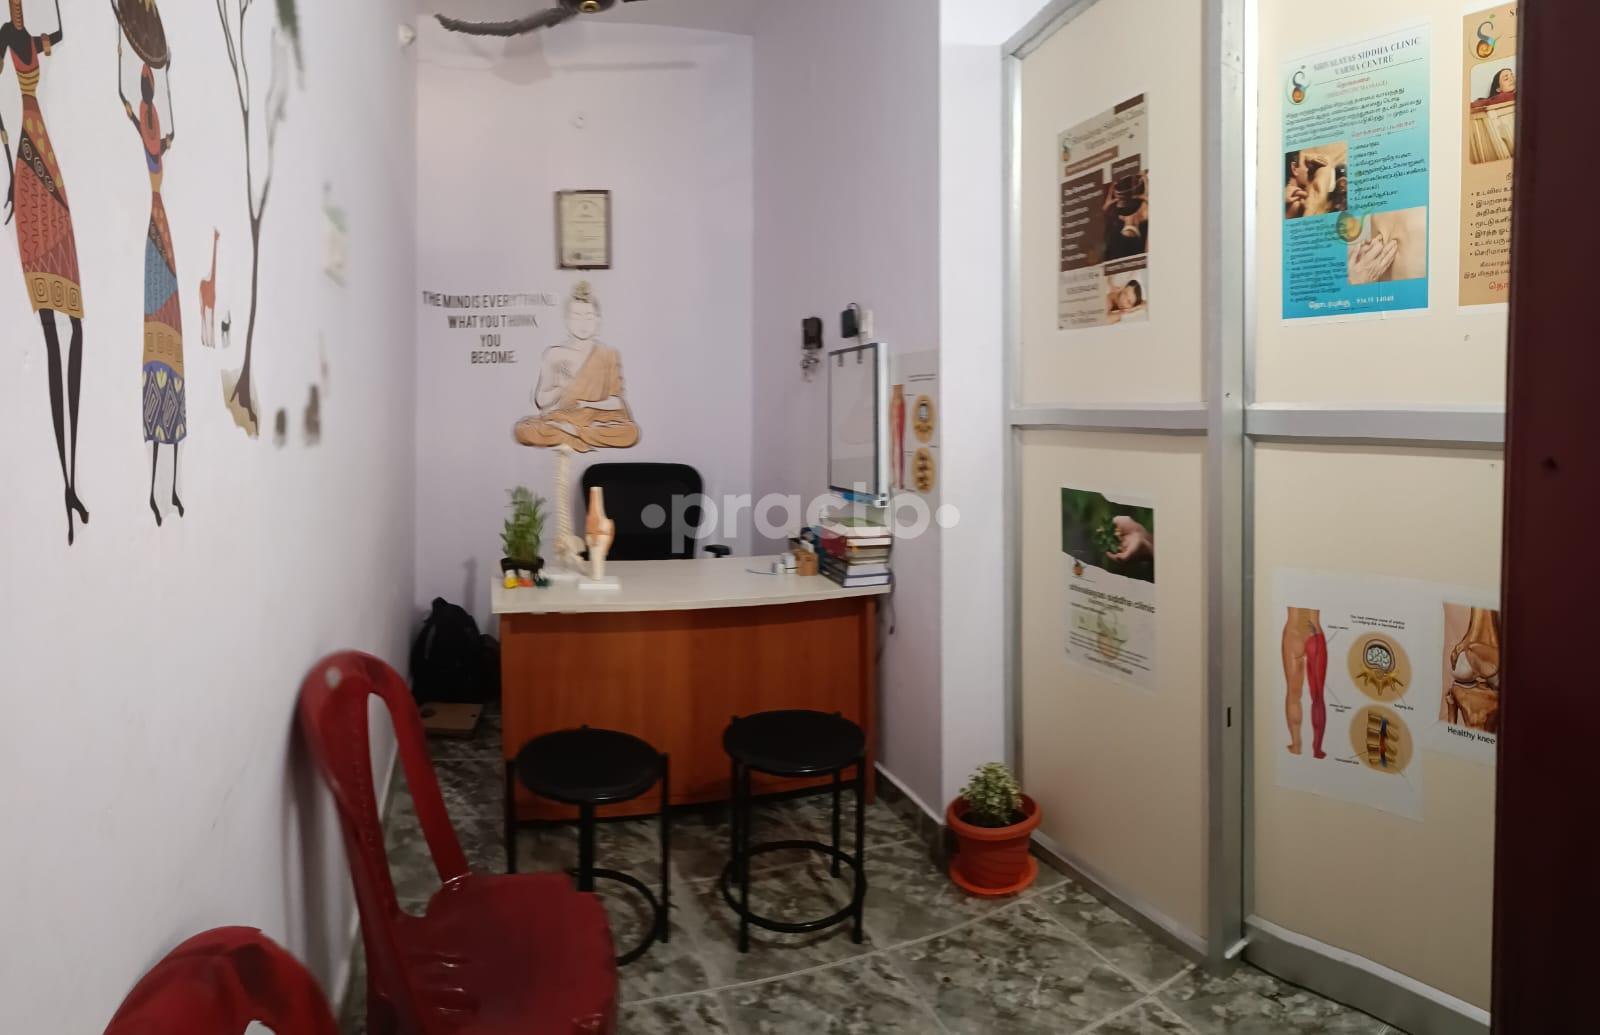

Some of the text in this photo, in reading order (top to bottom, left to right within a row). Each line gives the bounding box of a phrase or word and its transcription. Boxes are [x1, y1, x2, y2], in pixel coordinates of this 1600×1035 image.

[1357, 46, 1389, 60] SIDDHA
[1390, 37, 1420, 52] CLINIC
[1361, 55, 1394, 69] CENTRE
[422, 290, 441, 307] THE
[442, 294, 471, 308] MIND
[471, 295, 480, 308] IS
[447, 315, 477, 328] WHAT
[480, 315, 499, 328] YOU
[480, 334, 501, 347] YOU
[1447, 725, 1496, 745] Healthy knee
